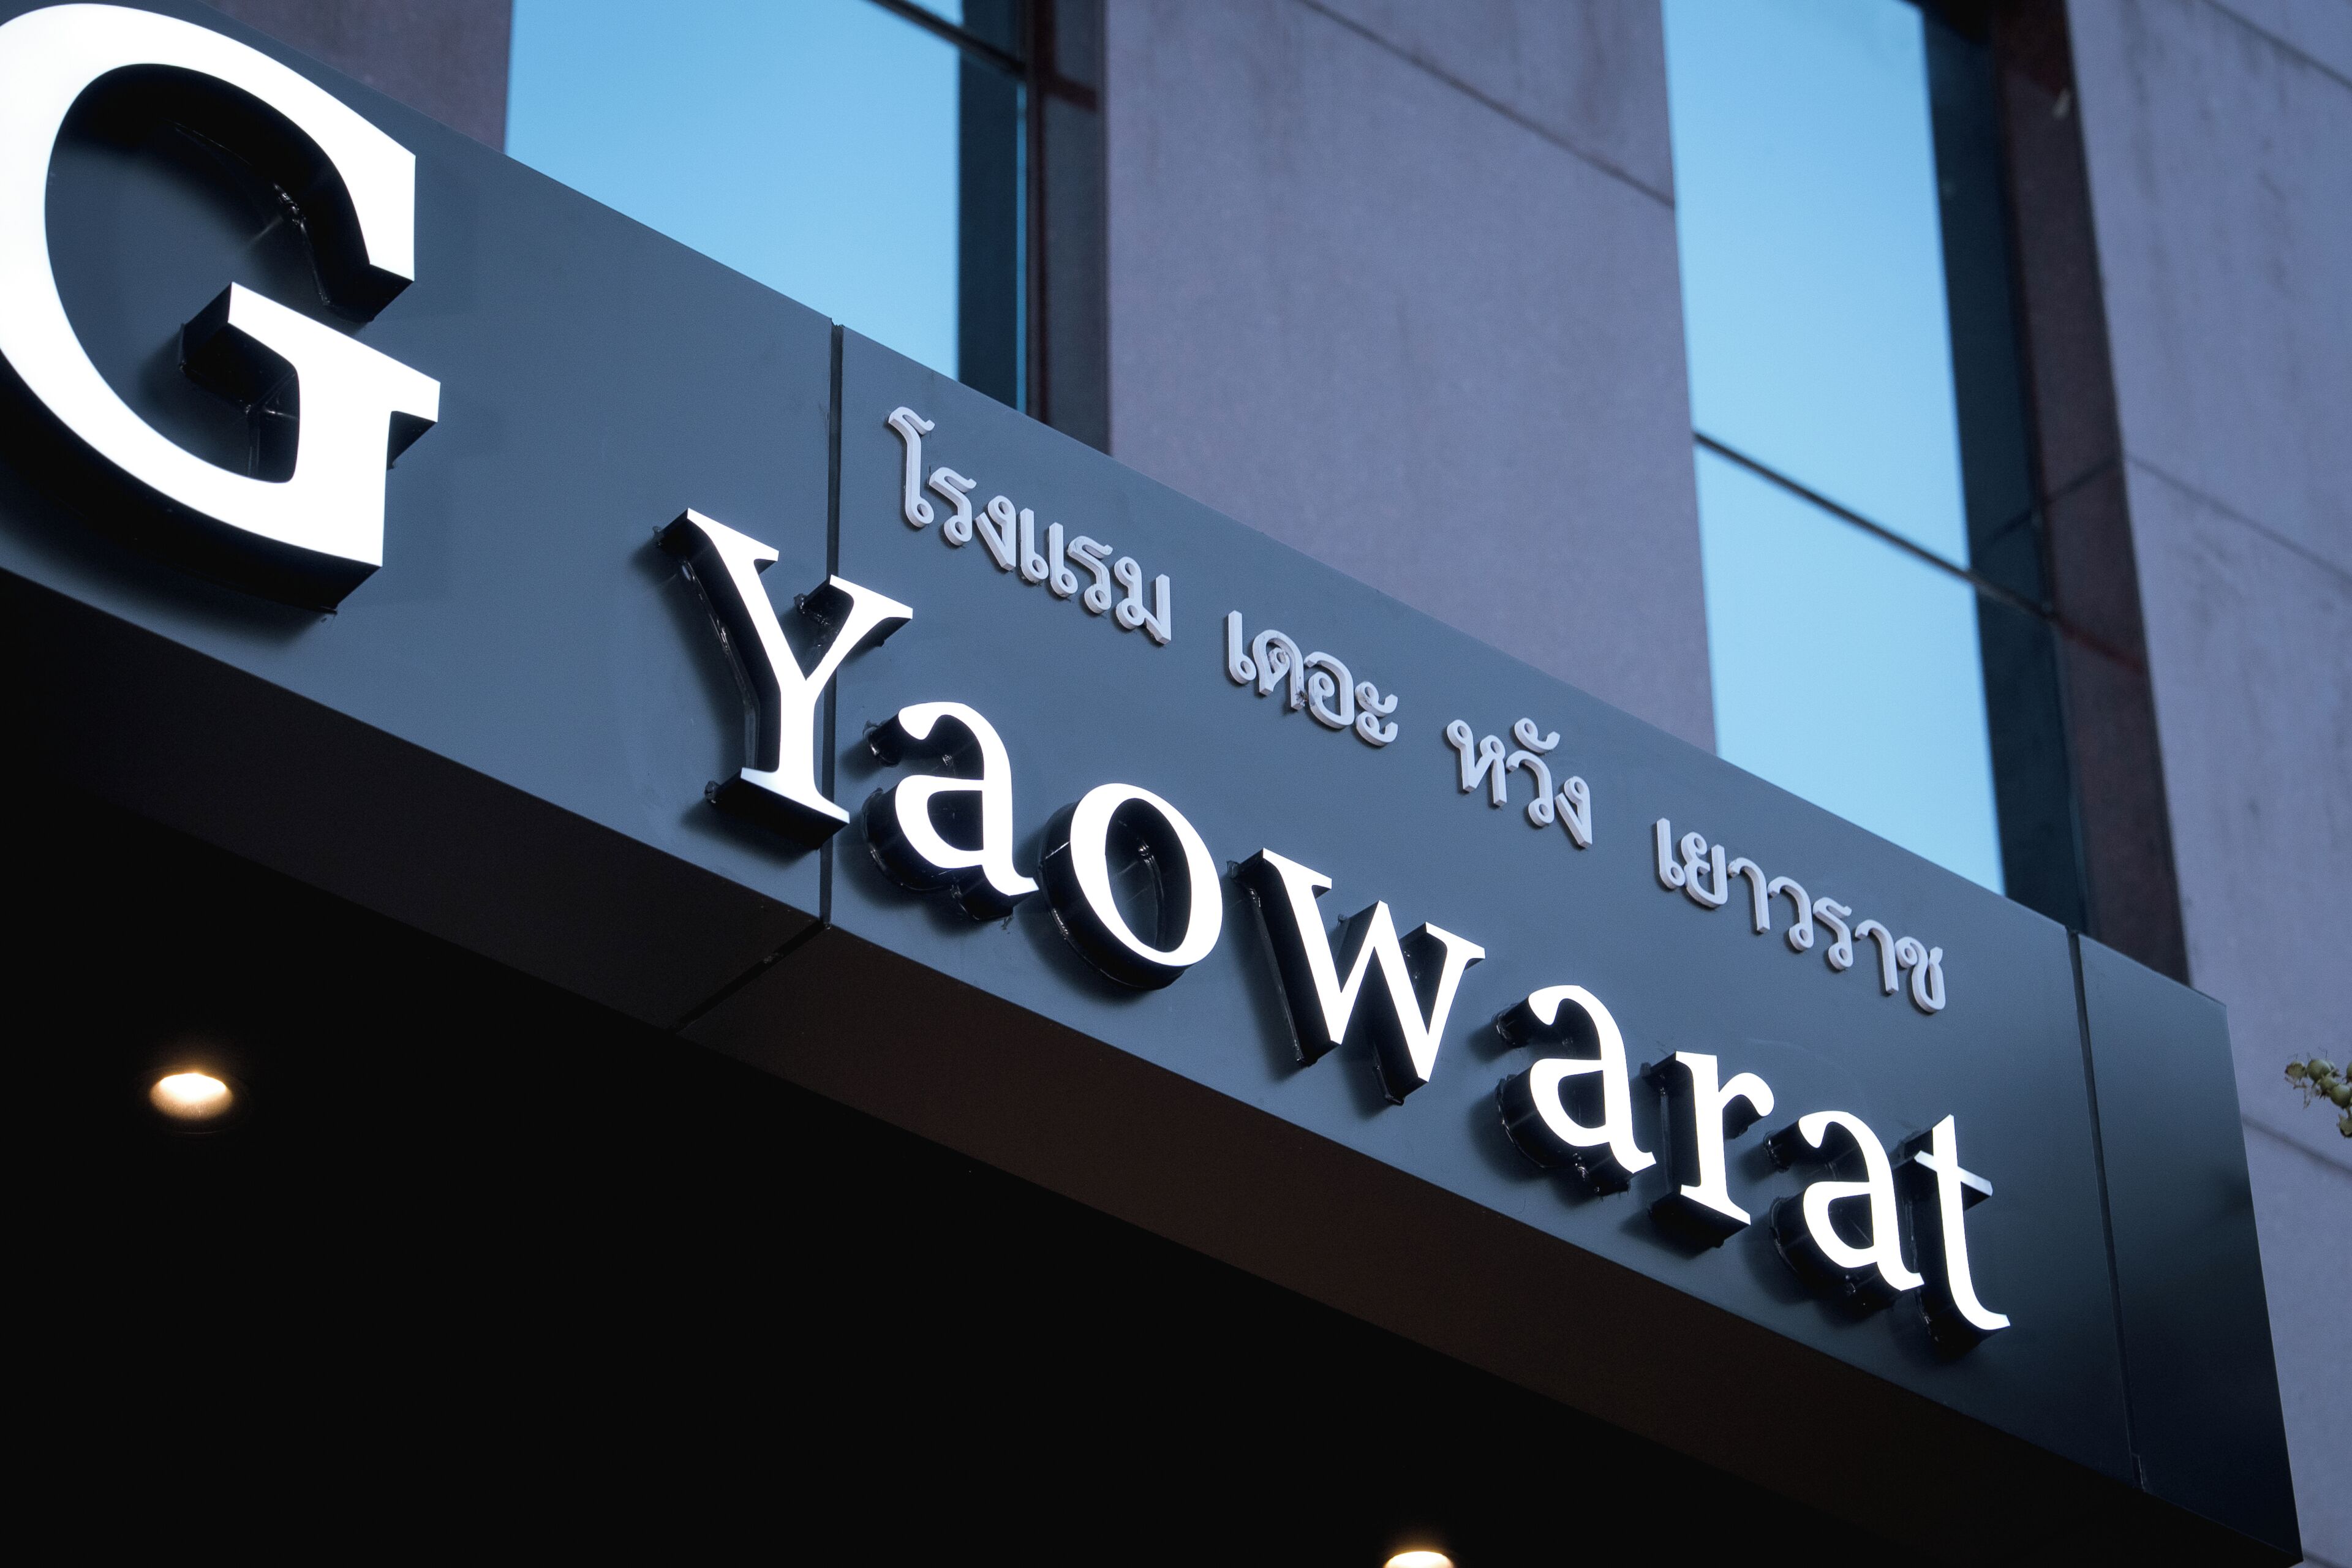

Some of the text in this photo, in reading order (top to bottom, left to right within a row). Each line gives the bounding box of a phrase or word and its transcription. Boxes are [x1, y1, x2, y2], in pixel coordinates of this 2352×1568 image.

[685, 508, 2010, 1331] Yaowarat
[888, 407, 1946, 1012] โรงแรม เดอะ หวัง เยาวราช
